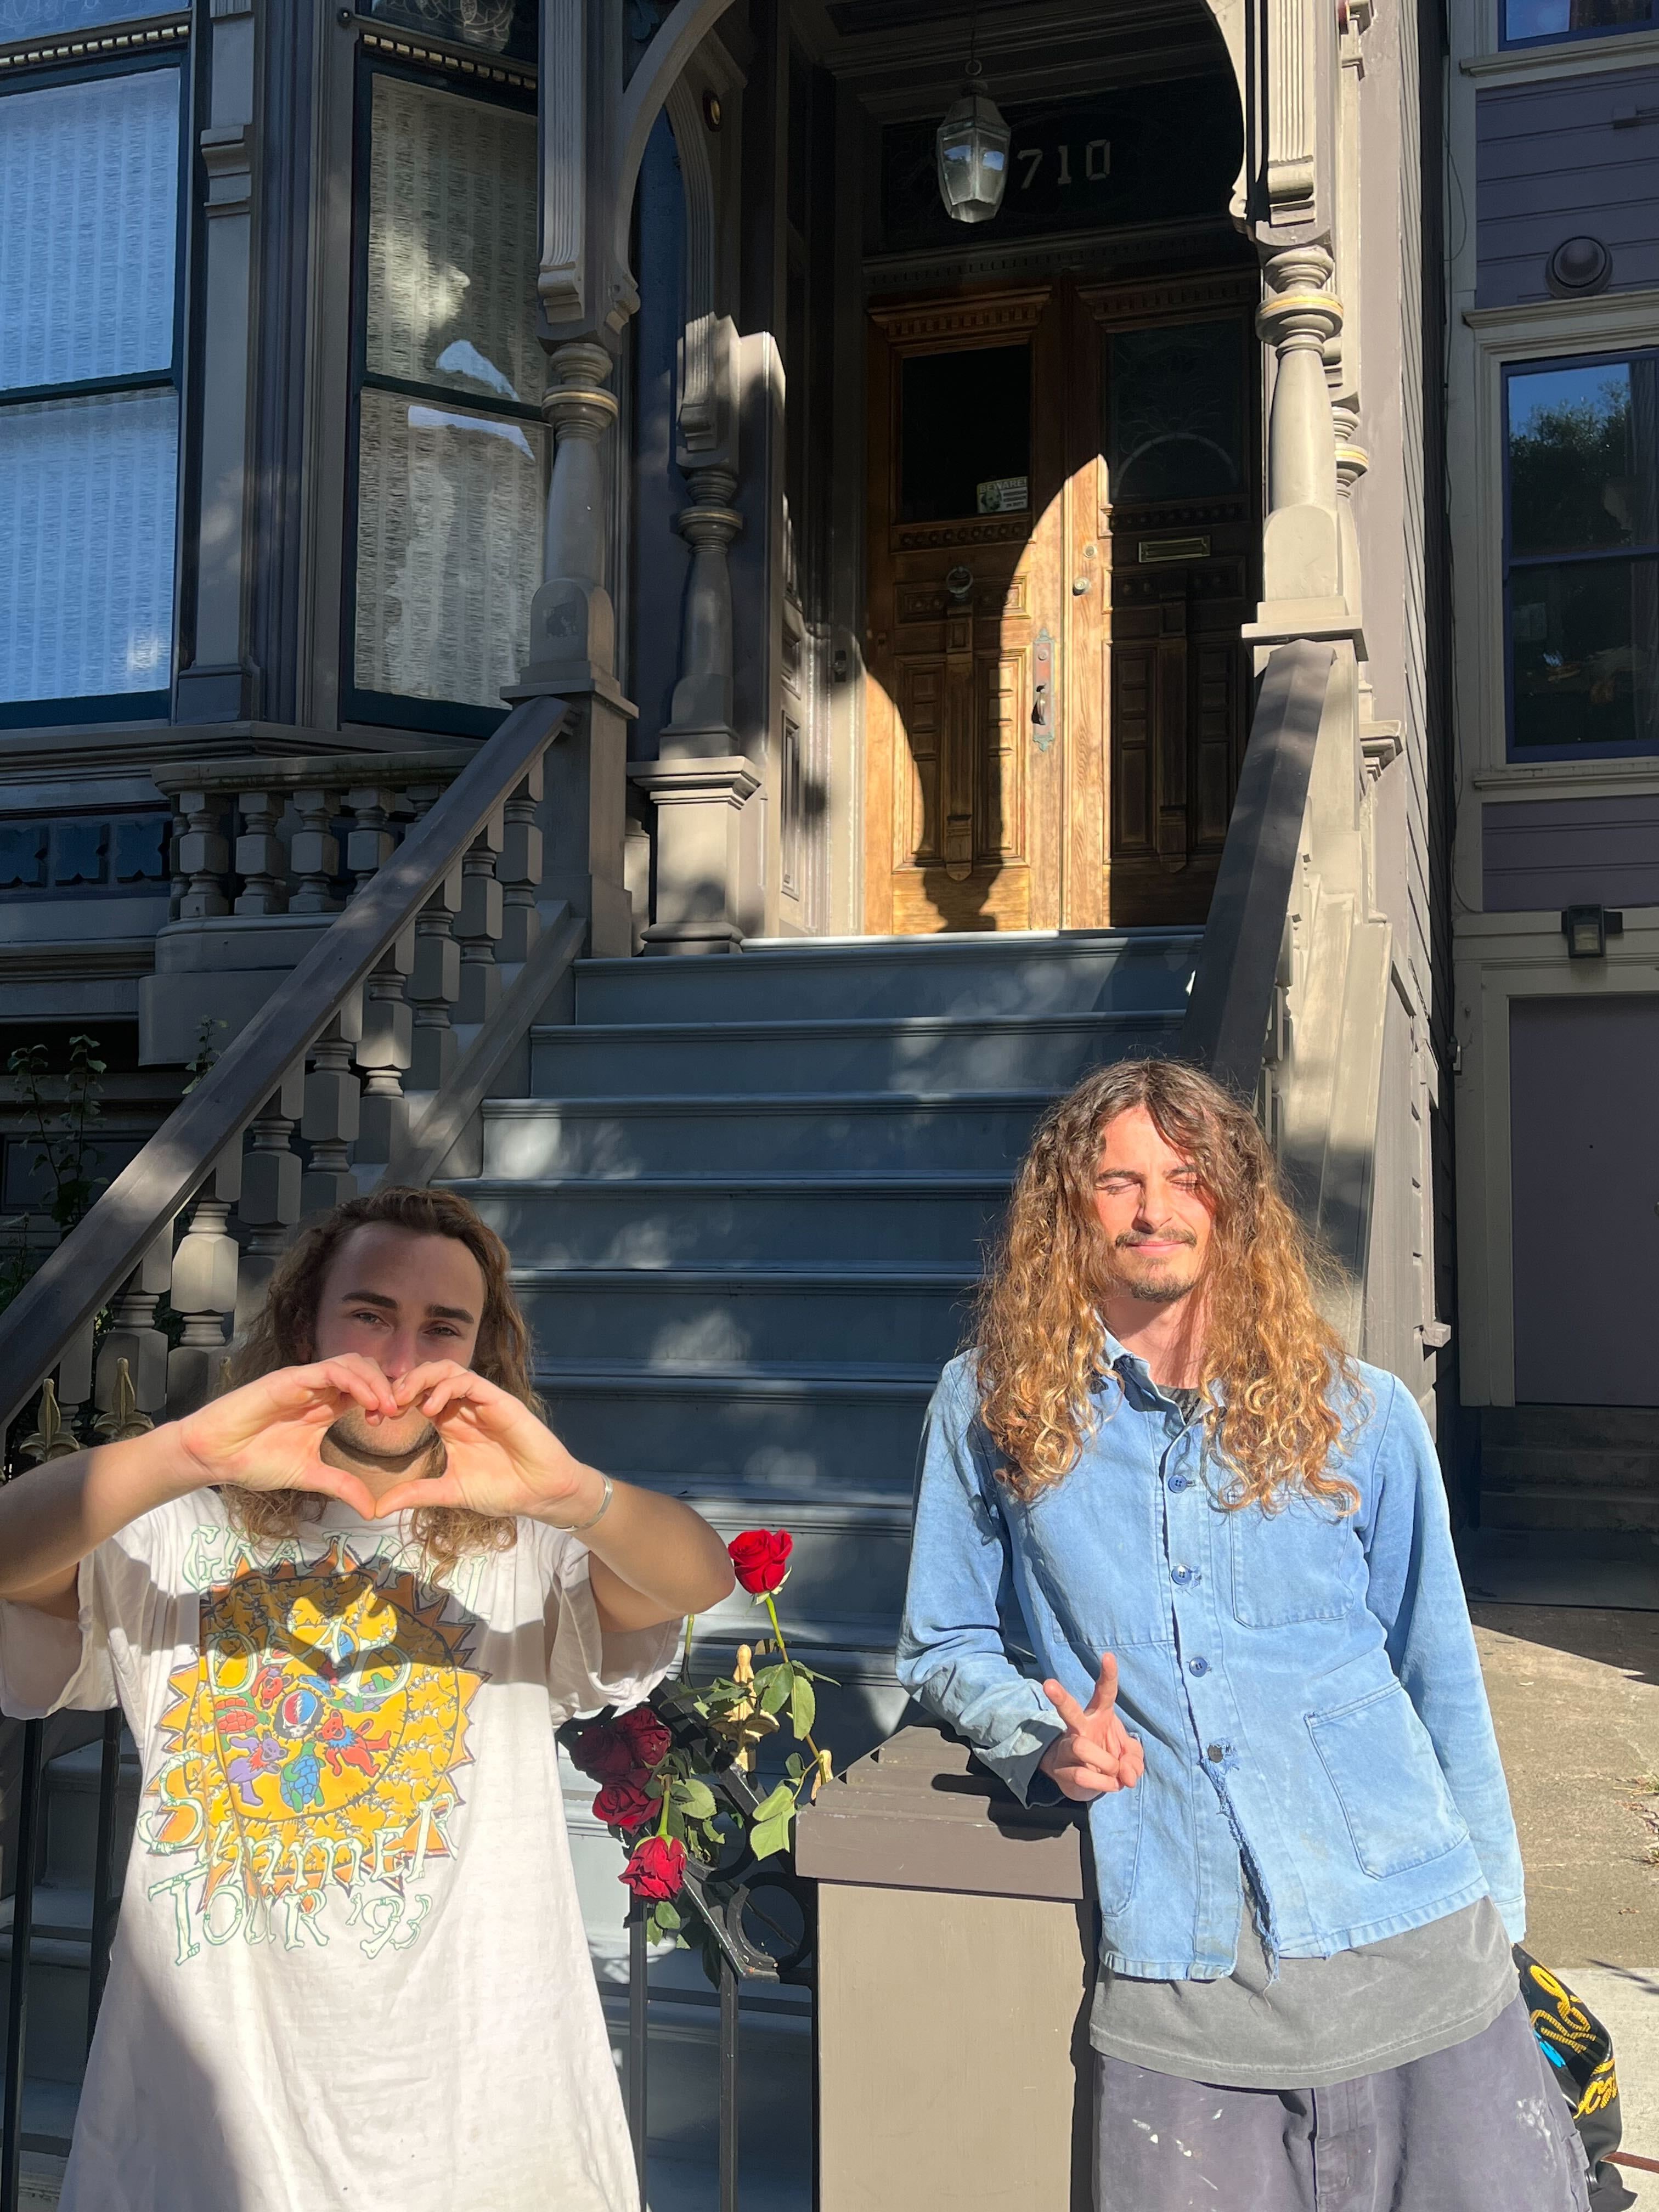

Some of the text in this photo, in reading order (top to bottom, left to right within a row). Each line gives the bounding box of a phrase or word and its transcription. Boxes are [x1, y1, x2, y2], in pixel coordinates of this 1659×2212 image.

[1017, 139, 1111, 190] 710
[979, 478, 1027, 493] BEWARE!
[205, 1615, 412, 1698] DEAD
